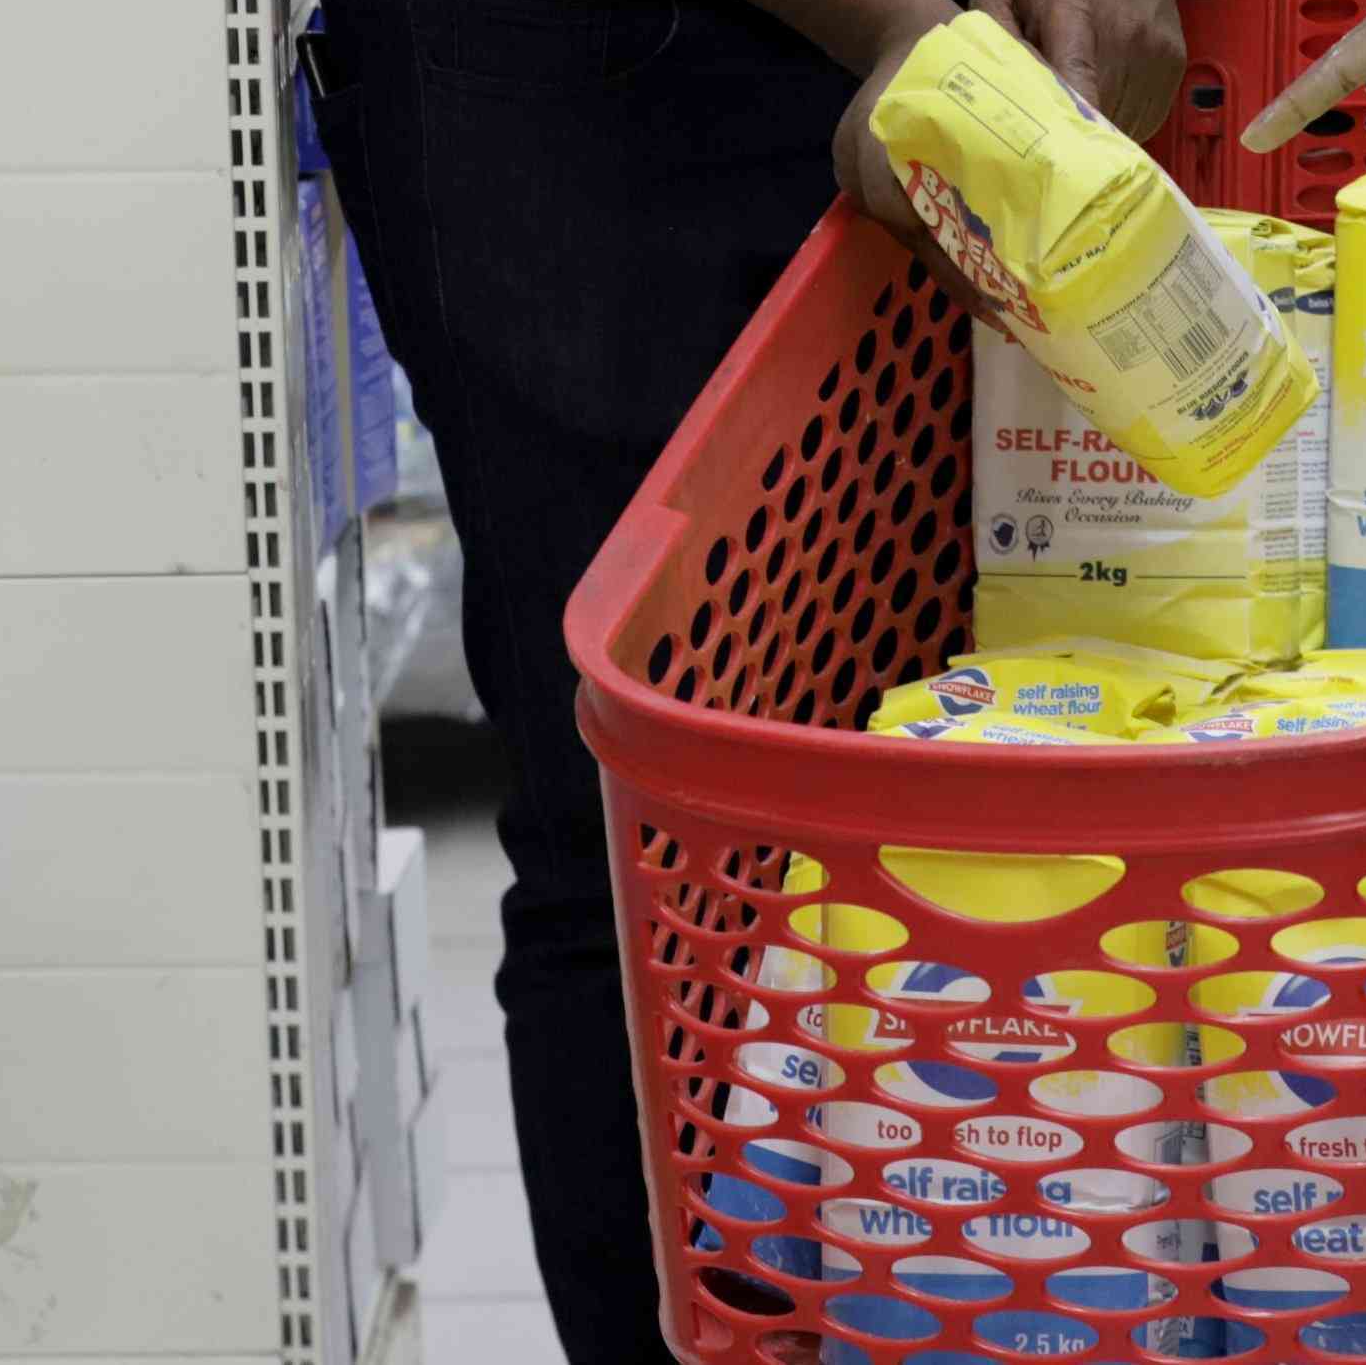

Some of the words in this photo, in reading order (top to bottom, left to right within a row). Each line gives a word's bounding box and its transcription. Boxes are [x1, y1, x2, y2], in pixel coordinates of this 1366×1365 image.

[1016, 487, 1063, 505] Rises
[1067, 488, 1120, 512] Every
[1123, 489, 1195, 512] Baking
[1064, 507, 1143, 523] Occasion
[1079, 561, 1128, 587] 2kg
[1017, 684, 1048, 701] self
[1050, 682, 1100, 701] raising
[1013, 698, 1064, 716] wheat
[1067, 699, 1103, 715] flour
[1276, 717, 1308, 733] self
[877, 1120, 913, 1141] too
[987, 1124, 1010, 1147] to
[1016, 1126, 1063, 1152] flop
[1299, 1136, 1358, 1159] fresh
[1254, 1181, 1317, 1215] self
